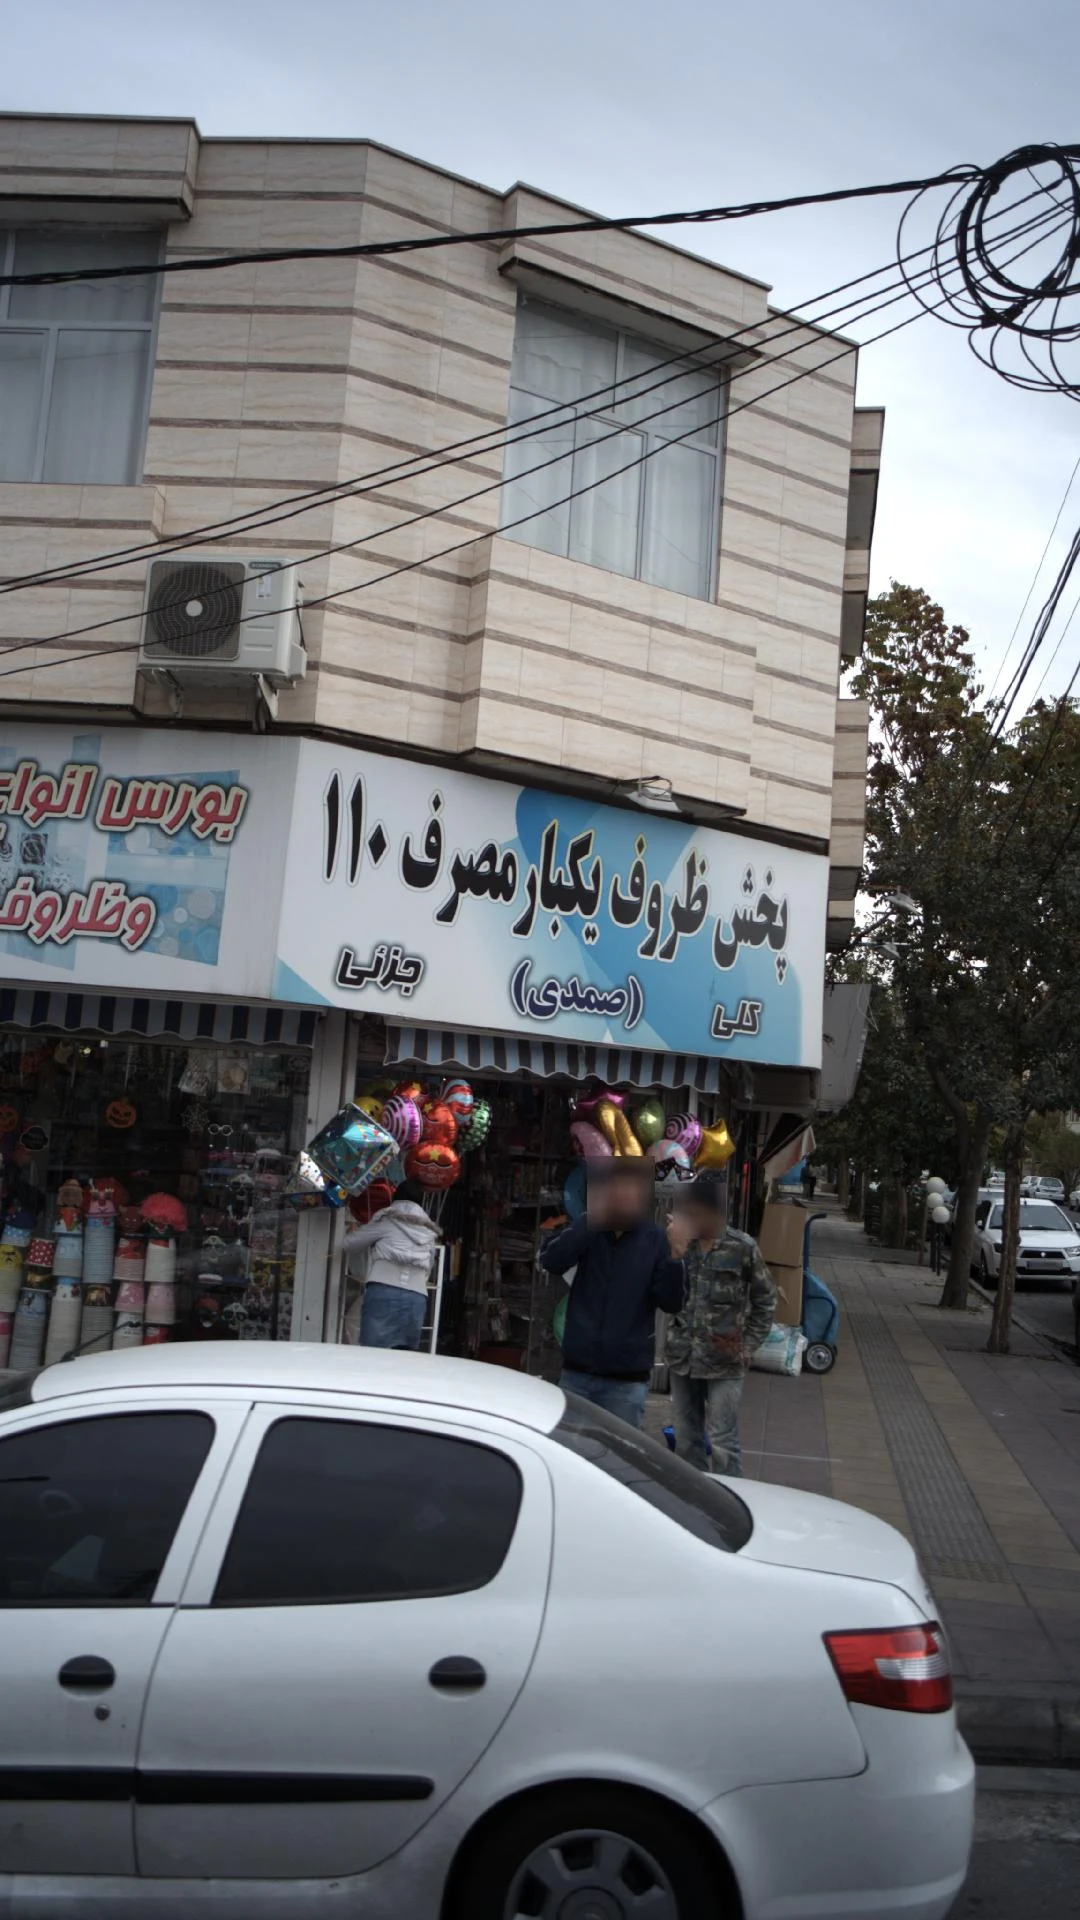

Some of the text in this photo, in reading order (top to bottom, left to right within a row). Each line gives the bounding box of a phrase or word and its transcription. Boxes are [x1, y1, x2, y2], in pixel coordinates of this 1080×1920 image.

[97, 779, 248, 841] بورس
[325, 770, 788, 984] پخش ظروف یکبار مصرف ۱۱۰
[511, 959, 643, 1029] (صمدی)
[711, 1000, 761, 1039] کلی
